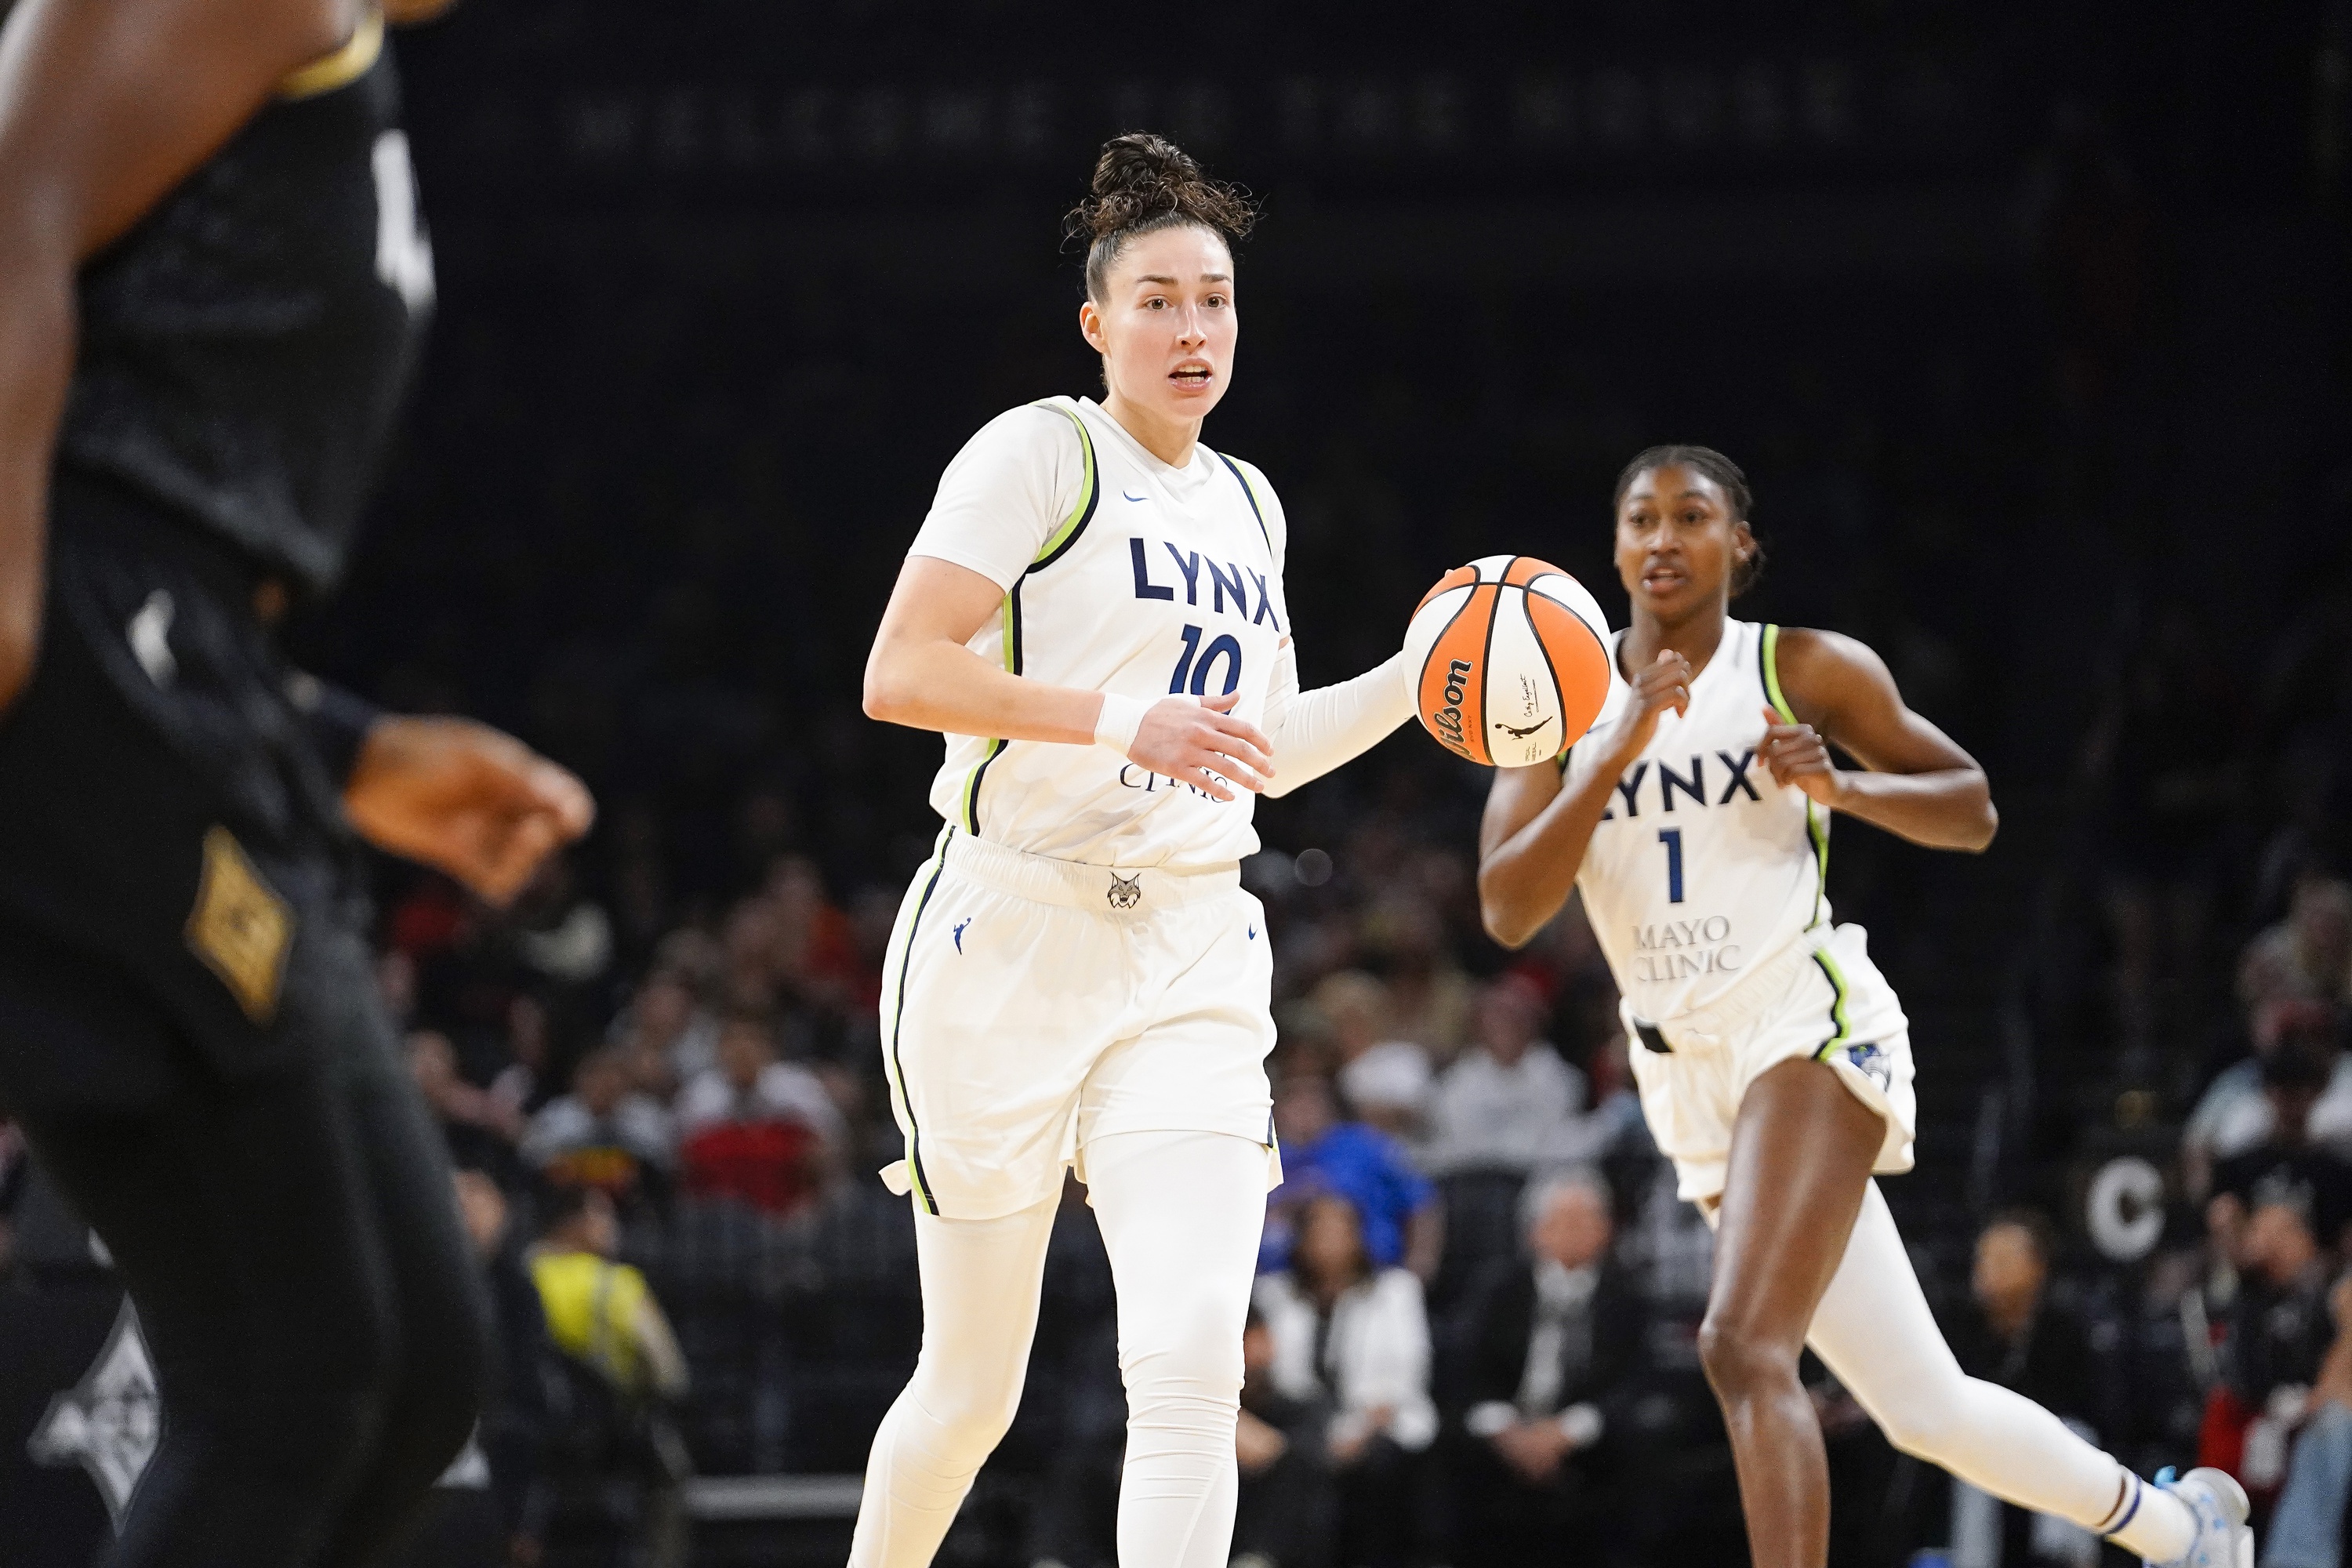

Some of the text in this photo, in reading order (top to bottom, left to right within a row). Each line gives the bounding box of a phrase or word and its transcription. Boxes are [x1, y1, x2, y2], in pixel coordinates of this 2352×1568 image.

[1130, 538, 1279, 632] LYNX
[1169, 623, 1241, 714] 10
[1602, 747, 1762, 821] YNX
[1659, 828, 1683, 903] 1
[1631, 915, 1731, 950] MAYO
[1634, 944, 1742, 982] CLINIC
